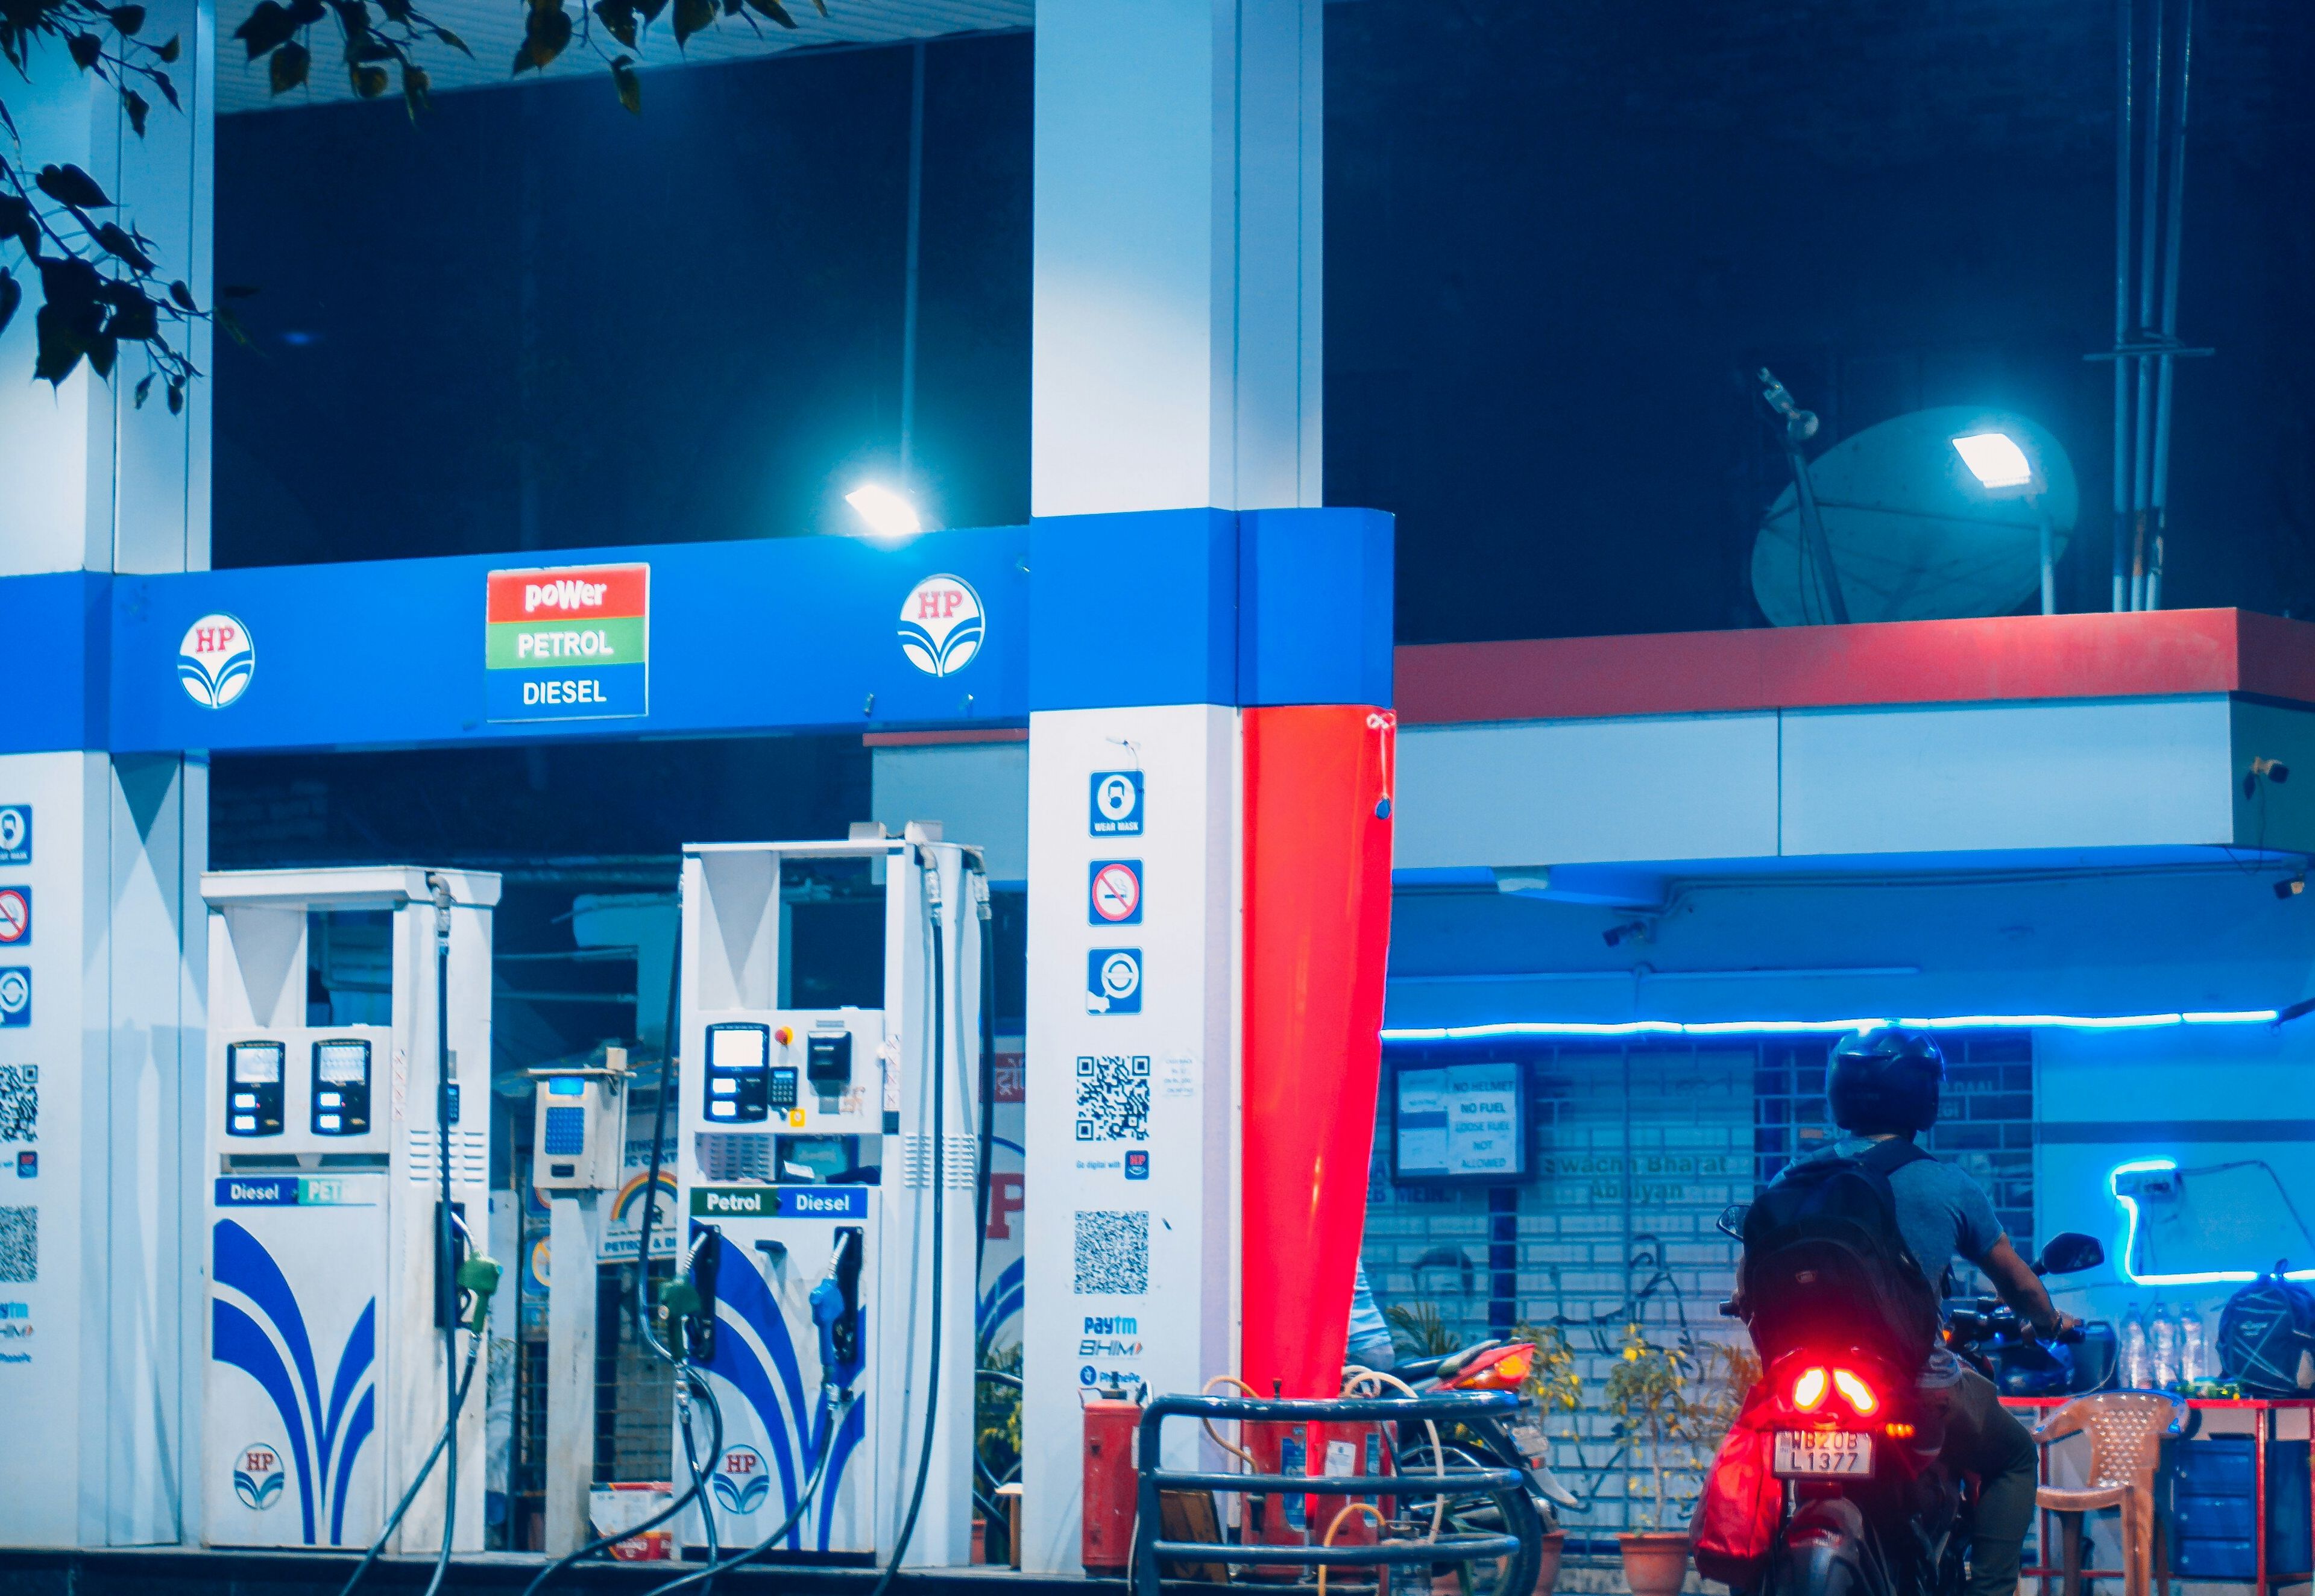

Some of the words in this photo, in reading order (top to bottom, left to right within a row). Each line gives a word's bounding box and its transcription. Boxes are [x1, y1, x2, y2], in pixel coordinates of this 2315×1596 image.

[918, 590, 963, 619] HP
[195, 626, 235, 653] HP
[517, 629, 614, 658] PETROL
[523, 679, 607, 705] DIESEL
[1094, 822, 1115, 831] WEAR
[1118, 821, 1139, 831] MASK
[1454, 1082, 1468, 1092] NO
[1460, 1102, 1476, 1114] NO
[1479, 1102, 1506, 1114] FUEL
[1648, 1156, 1728, 1173] Bhaat
[231, 1183, 279, 1201] Diesel
[707, 1192, 761, 1211] Petrol
[796, 1192, 850, 1211] Diesel
[1079, 1339, 1135, 1356] BHIM
[1099, 1372, 1140, 1383] PhnePe
[245, 1453, 275, 1472] HP
[725, 1454, 757, 1474] HP
[1791, 1451, 1859, 1471] L1377
